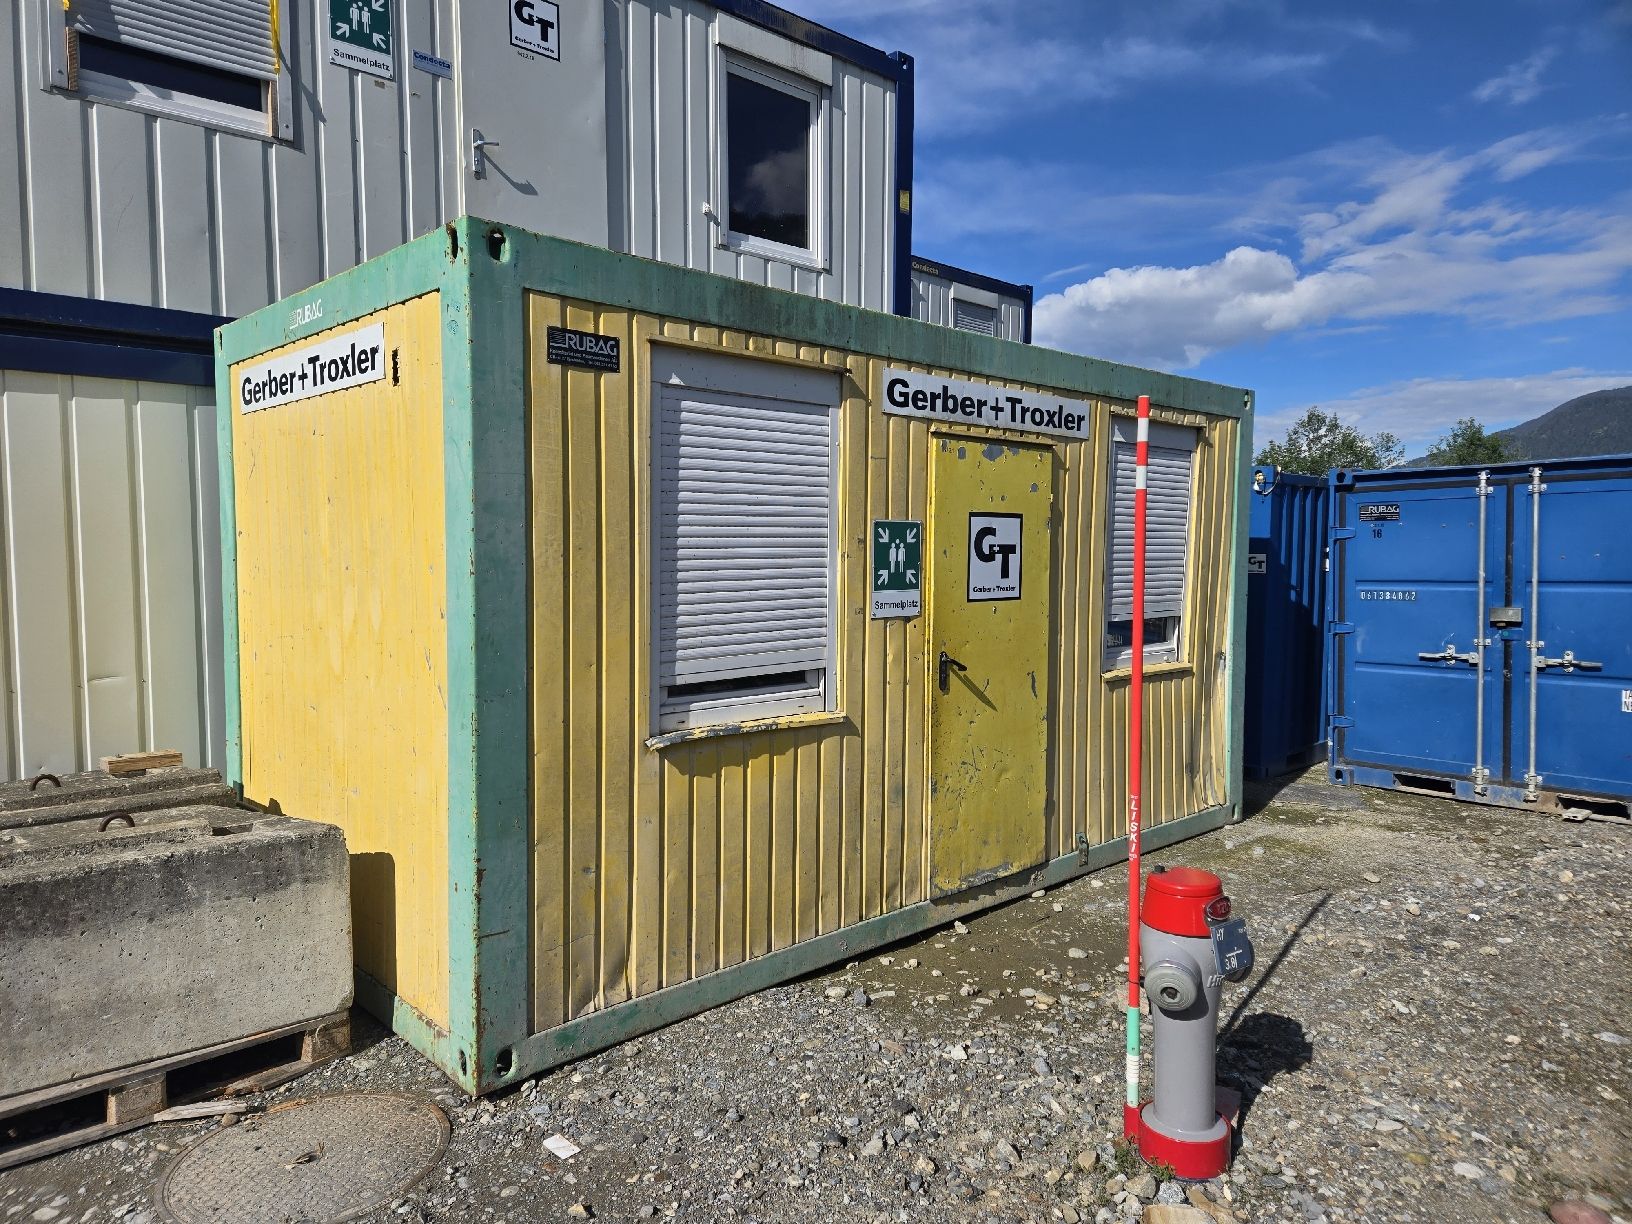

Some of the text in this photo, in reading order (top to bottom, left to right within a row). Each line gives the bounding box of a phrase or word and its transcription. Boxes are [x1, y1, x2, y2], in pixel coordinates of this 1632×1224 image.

[333, 48, 391, 72] Sammelplatz
[295, 299, 323, 326] RUBAG
[565, 332, 617, 356] RUBAG
[241, 342, 380, 405] Gerber+Troxler
[886, 377, 1087, 432] Gerber+Troxler
[1368, 505, 1400, 513] RUBAG
[1372, 528, 1382, 539] 16
[874, 599, 919, 611] Sammelplatz
[1129, 799, 1139, 853] LISKI
